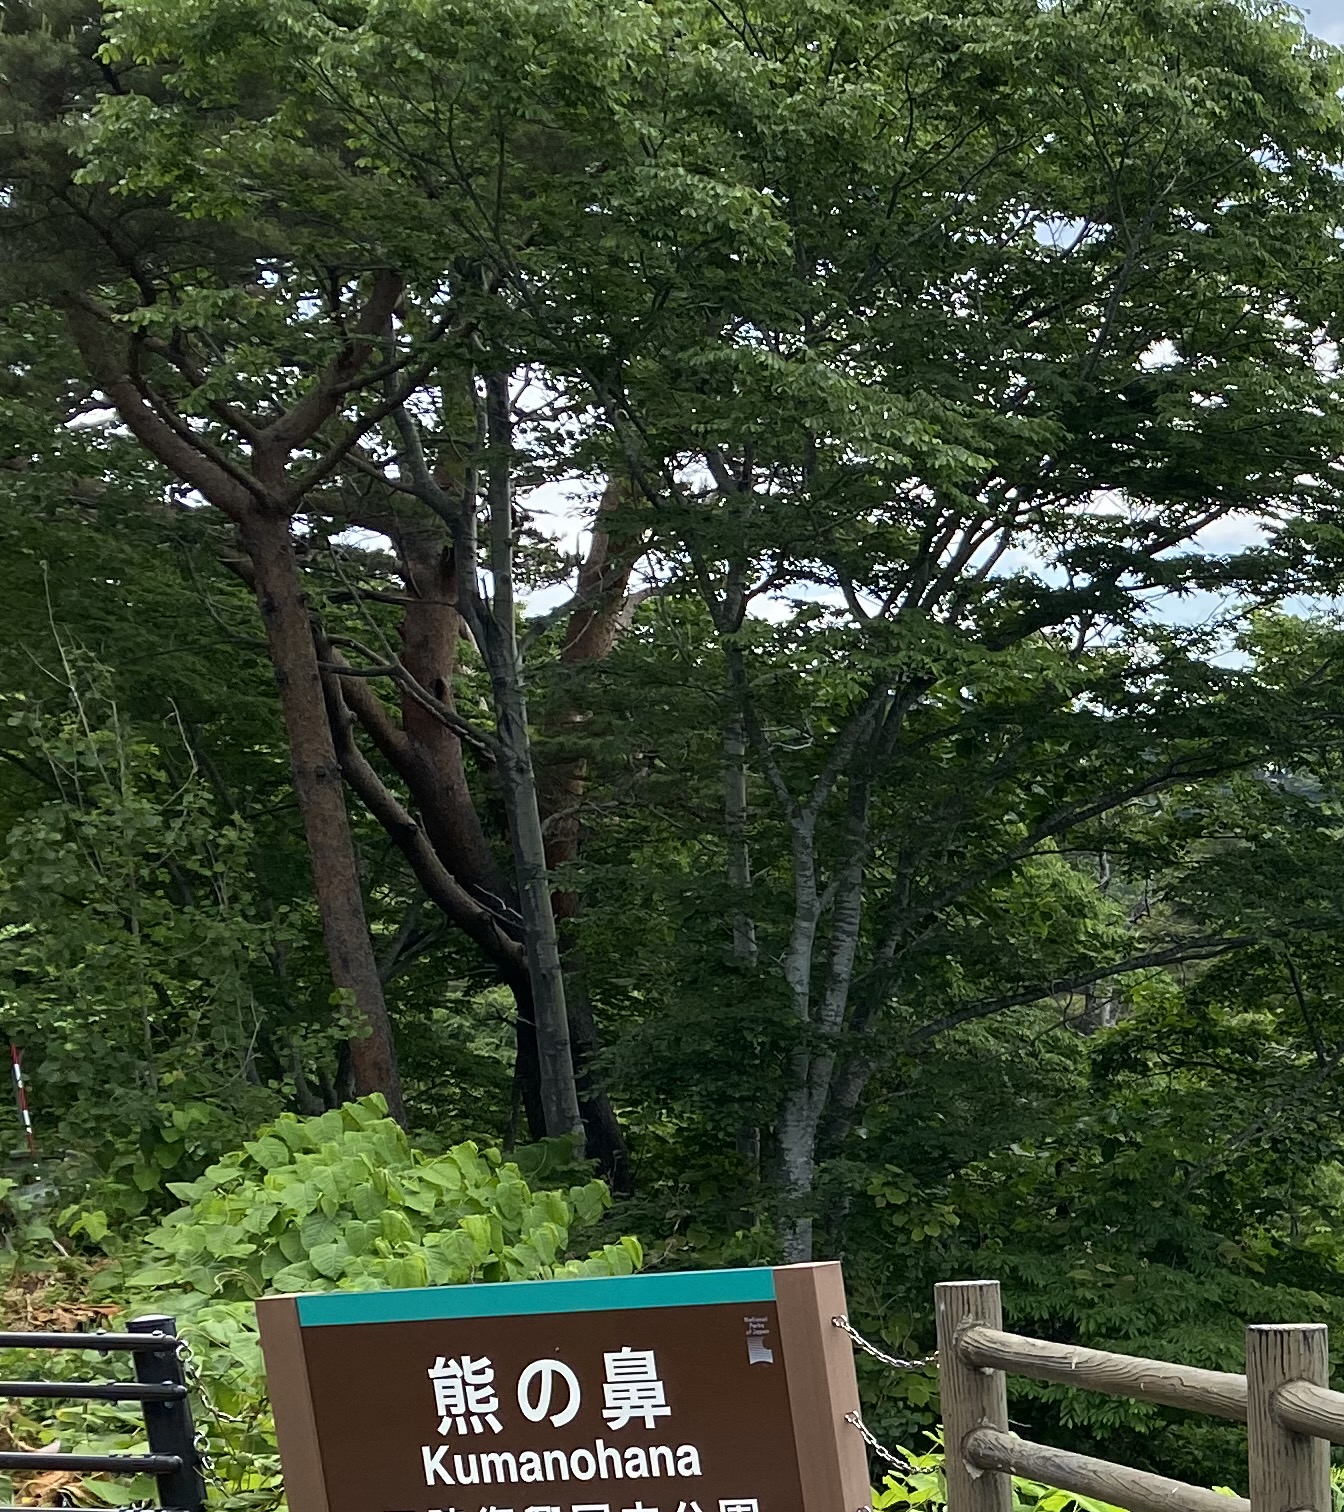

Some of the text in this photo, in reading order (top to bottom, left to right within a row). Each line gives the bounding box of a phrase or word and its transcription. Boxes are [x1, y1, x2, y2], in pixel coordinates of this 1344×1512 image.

[427, 1346, 672, 1436] 熊の鼻
[421, 1438, 703, 1486] Kumanohana
